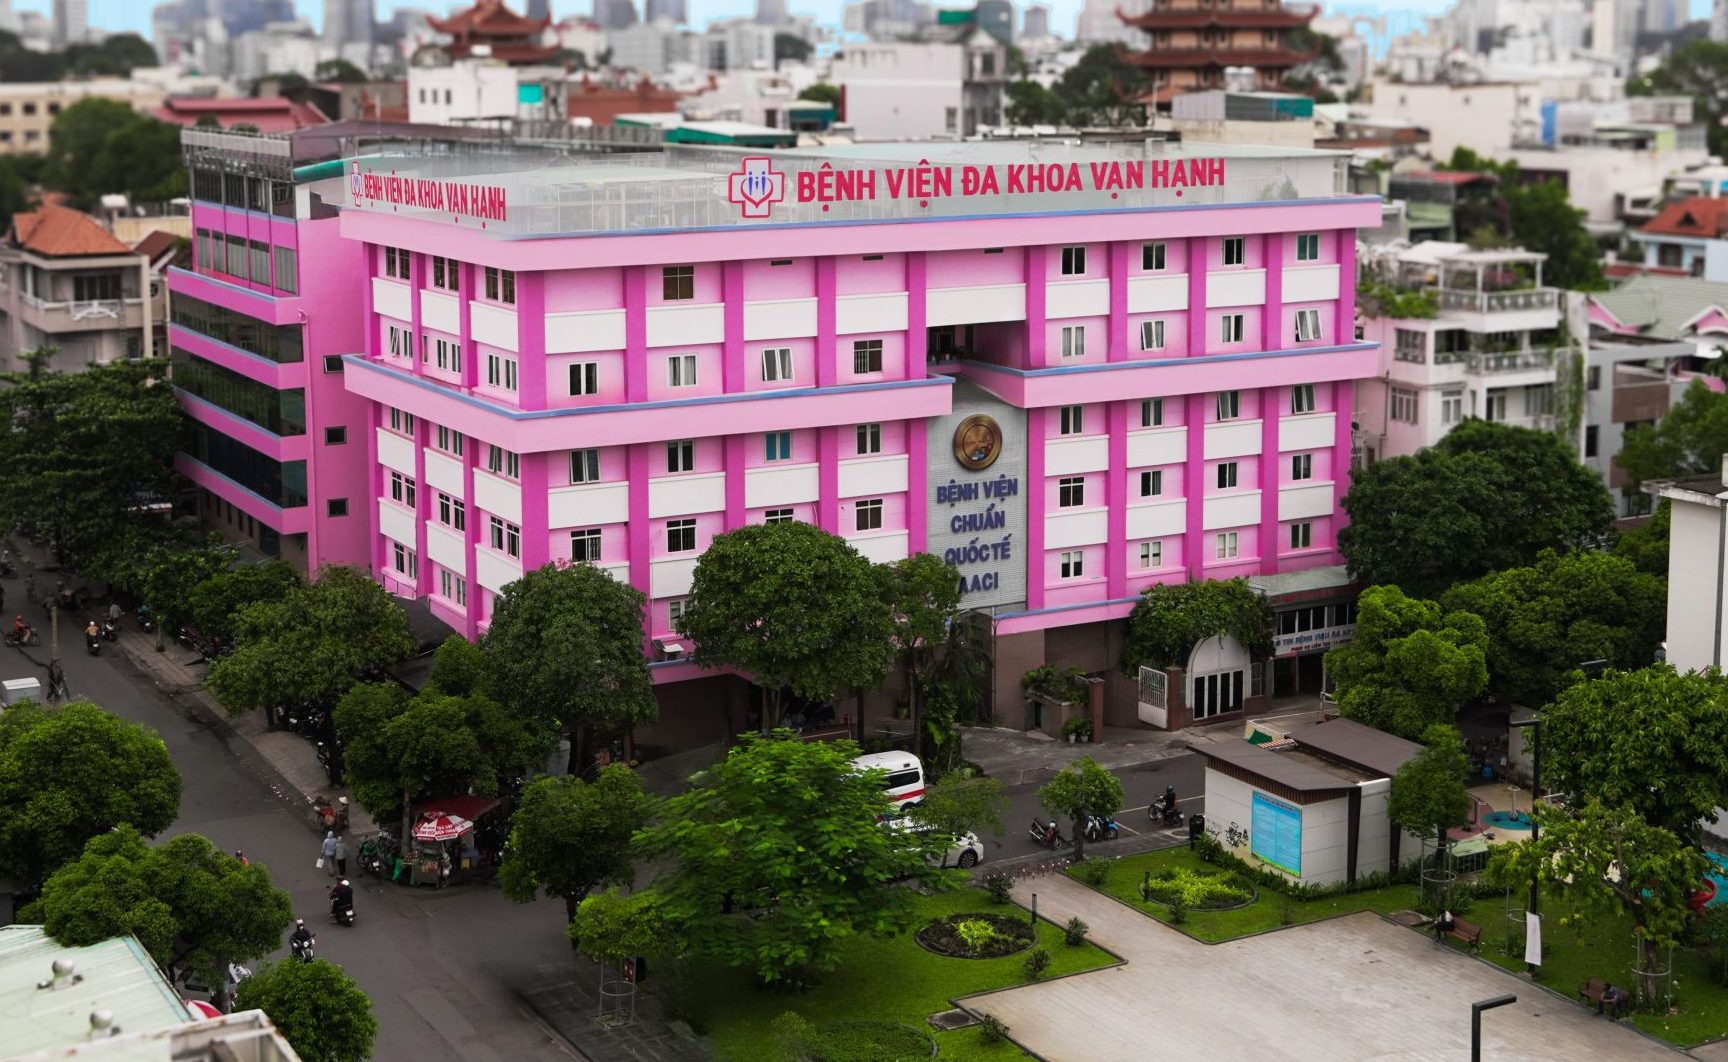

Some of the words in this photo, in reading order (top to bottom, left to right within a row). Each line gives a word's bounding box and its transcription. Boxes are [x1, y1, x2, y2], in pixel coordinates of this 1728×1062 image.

[364, 168, 383, 207] BỆNH
[384, 169, 402, 212] VIỆN
[404, 178, 417, 207] ĐA
[417, 179, 444, 211] KHOA
[445, 182, 468, 223] VẠN
[470, 185, 507, 229] HẠNH
[797, 162, 876, 212] BỆNH
[884, 158, 952, 208] VIỆN
[961, 165, 1000, 196] ĐA
[1007, 162, 1083, 194] KHOA
[1089, 160, 1145, 200] VẠN
[1151, 158, 1226, 198] HẠNH
[937, 479, 979, 507] BỆNH
[983, 474, 1018, 502] VIỆN
[951, 503, 1005, 532] CHUẨN
[944, 537, 989, 567] QUỐC
[990, 533, 1012, 561] TẾ
[958, 572, 999, 594] AACI
